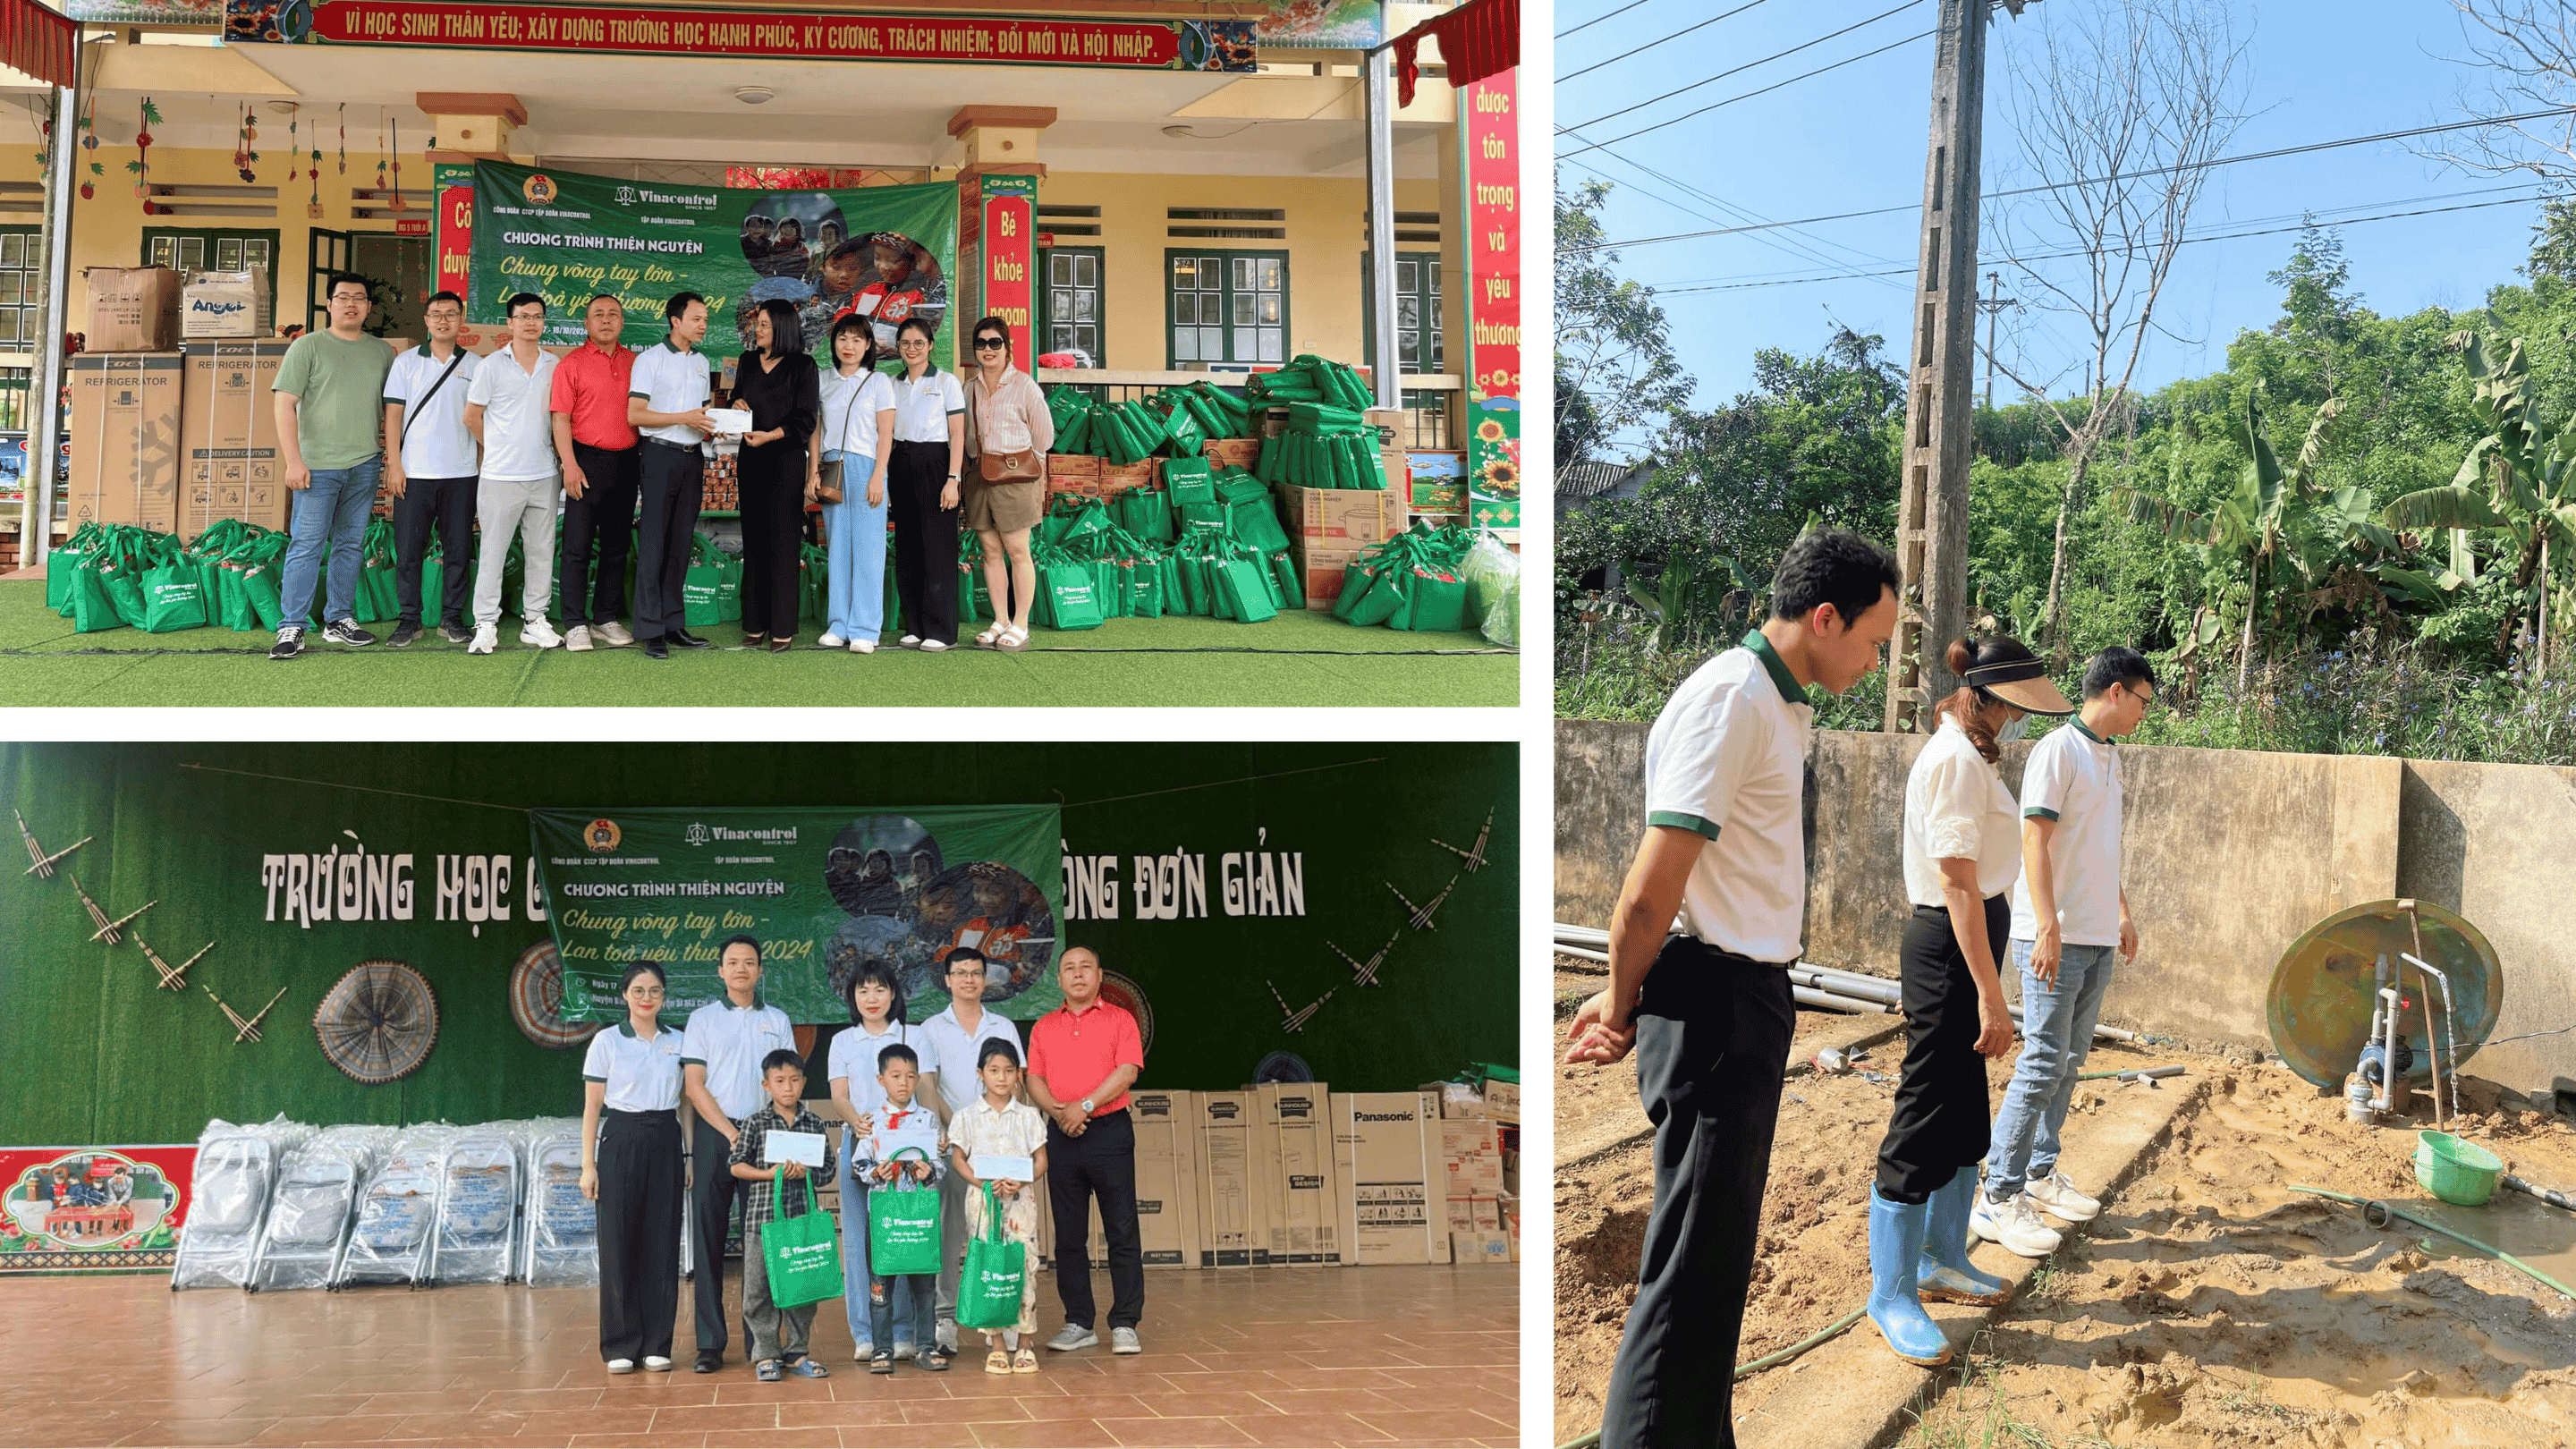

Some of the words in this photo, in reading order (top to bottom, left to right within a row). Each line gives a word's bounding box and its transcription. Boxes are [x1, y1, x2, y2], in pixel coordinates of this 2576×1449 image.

[345, 6, 360, 35] VÌ
[364, 12, 396, 39] HỌC
[401, 13, 439, 38] SINH
[444, 11, 485, 38] THÂN
[488, 12, 523, 41] YÊU;
[527, 13, 557, 41] XÂY
[562, 17, 605, 47] DỰNG
[609, 14, 670, 45] TRƯỜNG
[674, 22, 704, 50] HỌC
[708, 23, 750, 52] HẠNH
[755, 21, 800, 51] PHÚC,
[804, 15, 824, 49] KỶ
[827, 25, 884, 53] CƯƠNG,
[887, 22, 936, 52] TRÁCH
[940, 24, 994, 57] NHIỆM;
[997, 21, 1022, 55] ĐỔI
[1027, 26, 1055, 55] MỚI
[1061, 26, 1080, 55] VÀ
[1083, 29, 1108, 62] HỘI
[1113, 30, 1159, 63] NHẬP.
[1476, 83, 1510, 122] được
[1482, 131, 1505, 159] tôn
[639, 190, 717, 206] Vinacontrol
[1476, 182, 1514, 214] trọng
[455, 200, 472, 229] Cô
[559, 210, 591, 219] VINACONTROL
[1000, 210, 1016, 237] Bé
[503, 230, 561, 247] CHƯƠNG
[564, 232, 604, 249] TRÌNH
[606, 235, 645, 253] THIỆN
[648, 239, 703, 256] NGUYỆN
[1487, 224, 1505, 252] và
[443, 247, 471, 280] duy
[499, 255, 560, 286] Chung
[563, 261, 606, 288] vòng
[609, 264, 639, 289] tay
[643, 261, 674, 283] lớn
[993, 251, 1023, 282] khỏe
[1485, 270, 1511, 305] yêu
[567, 292, 591, 317] yê
[614, 291, 669, 320] hương
[198, 360, 277, 369] REFRIGERATOR
[85, 377, 167, 386] REFRIGERATOR
[208, 449, 241, 457] DELIVERY
[241, 449, 270, 457] CAUTION
[712, 826, 797, 840] Vinacontrol
[261, 829, 414, 928] TRƯỜNG
[435, 854, 512, 939] HỌC
[1133, 845, 1208, 920] ĐƠN
[1221, 826, 1306, 917] GIẢN
[564, 882, 628, 896] CHƯƠNG
[631, 879, 675, 895] TRÌNH
[679, 879, 721, 898] THIỆN
[724, 878, 784, 897] NGUYỆN
[563, 909, 628, 938] Chung
[632, 912, 679, 938] vòng
[684, 911, 716, 938] tay
[722, 909, 755, 928] lớn
[562, 939, 599, 960] Lan
[760, 939, 814, 960] 2024
[1353, 1110, 1414, 1122] Panasonic
